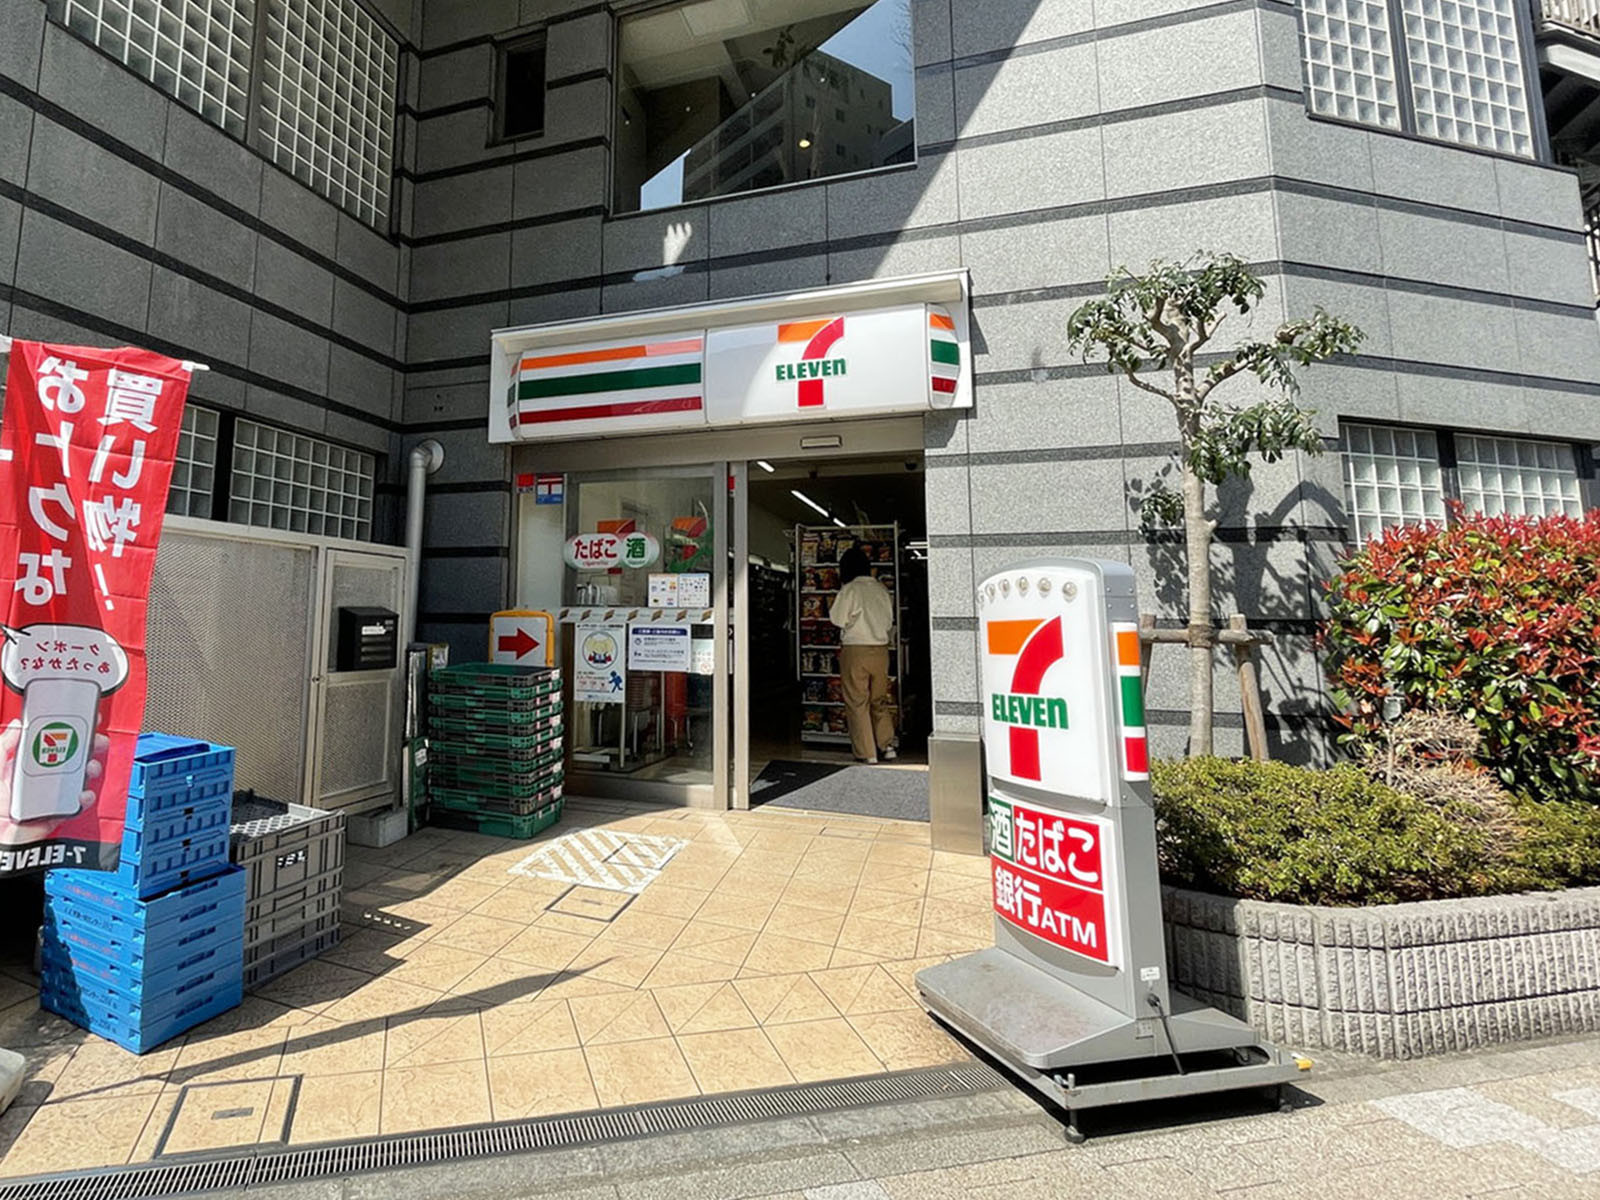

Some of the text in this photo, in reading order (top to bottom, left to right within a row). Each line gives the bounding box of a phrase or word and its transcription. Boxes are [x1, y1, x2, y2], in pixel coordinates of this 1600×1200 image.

[778, 317, 845, 407] 7
[574, 538, 646, 559] たばこ 酒
[986, 615, 1065, 782] 7
[990, 802, 1098, 883] 酒 たばこ
